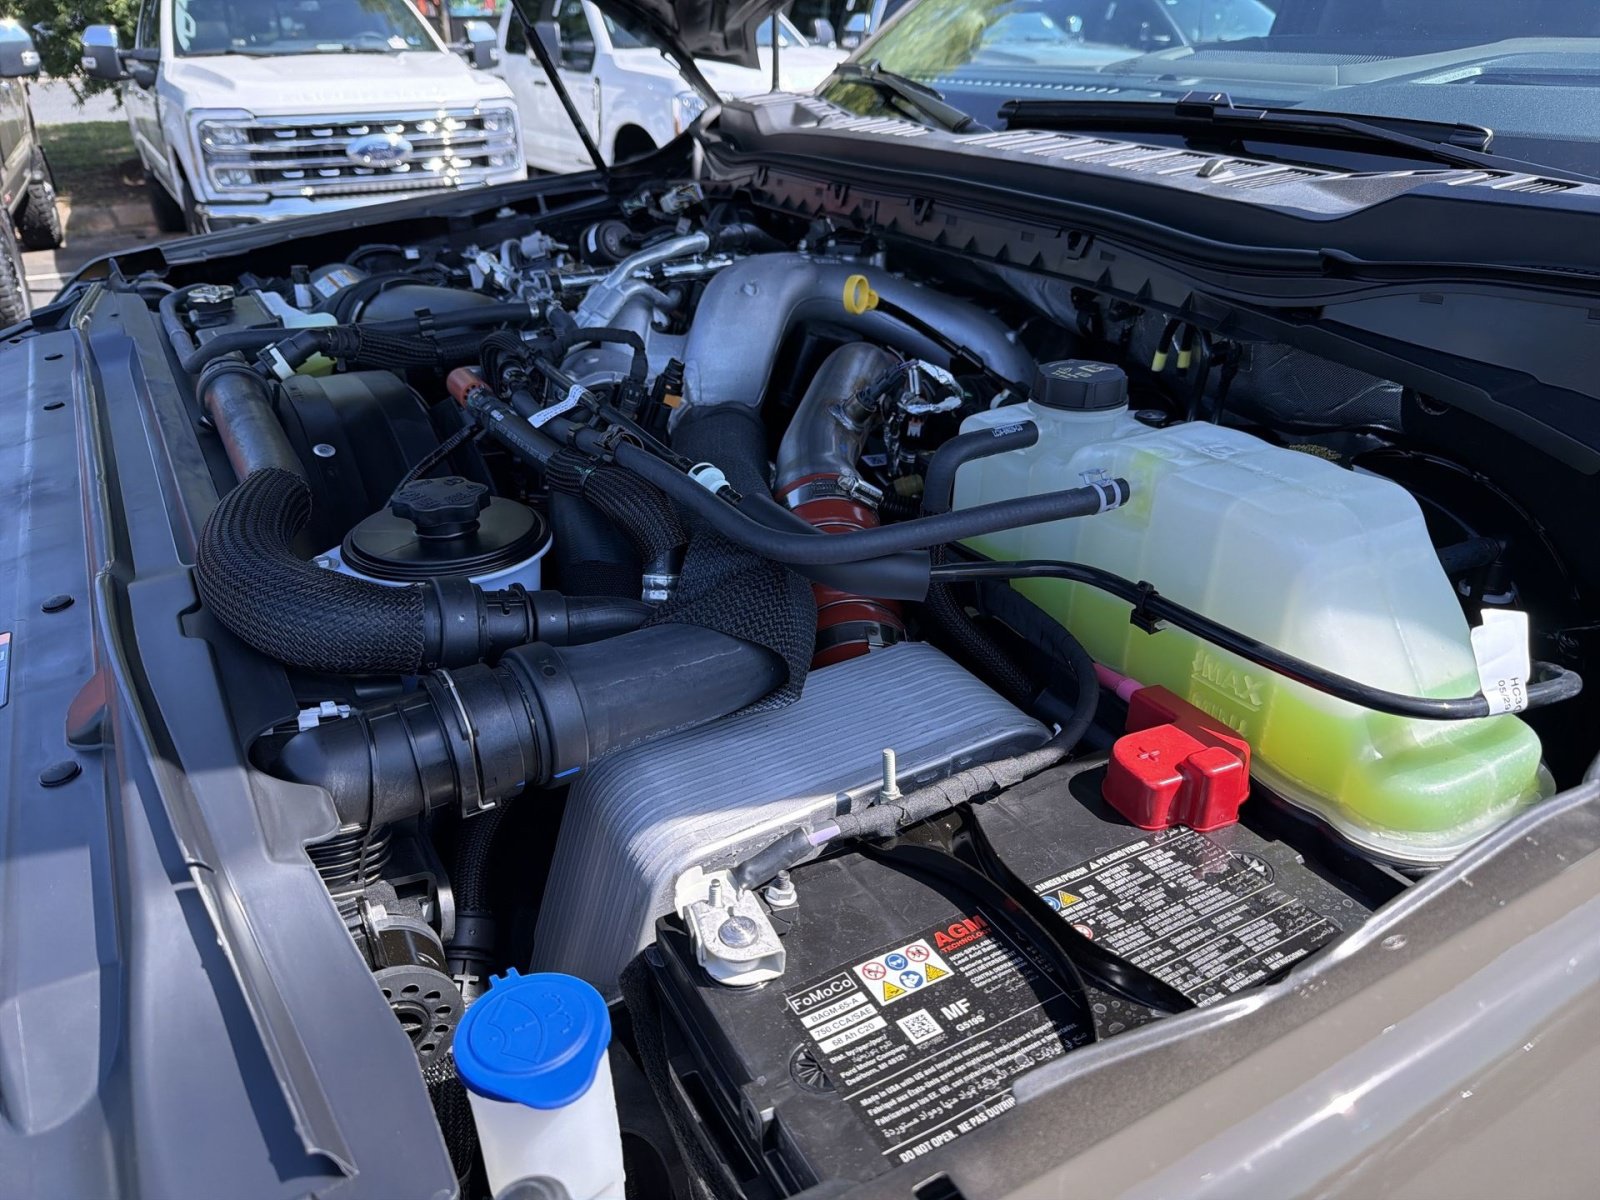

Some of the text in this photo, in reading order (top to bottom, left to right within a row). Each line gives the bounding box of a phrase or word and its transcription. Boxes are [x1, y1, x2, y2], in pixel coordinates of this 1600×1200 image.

[1202, 653, 1263, 706] MAX
[934, 914, 988, 947] AGM
[954, 956, 970, 966] Lead
[968, 950, 982, 958] Acid
[958, 960, 982, 972] Batterie
[970, 970, 994, 984] CONTRA
[791, 979, 852, 1010] FoMoCo
[810, 997, 859, 1023] BAGM-65-A
[940, 997, 971, 1021] MF
[815, 1006, 873, 1038] 750 CCA/SAE
[832, 1023, 875, 1047] 68 Ah C20
[840, 1067, 858, 1079] Ford
[857, 1059, 876, 1071] Motor
[940, 1070, 956, 1080] avec
[954, 1064, 966, 1074] des
[860, 1094, 880, 1106] Made
[878, 1090, 888, 1098] in
[884, 1084, 902, 1094] USA
[900, 1078, 916, 1088] with
[912, 1072, 924, 1080] US
[924, 1066, 936, 1076] and
[916, 1096, 930, 1106] los
[900, 1150, 916, 1162] DO
[912, 1140, 932, 1156] NOT
[930, 1130, 958, 1148] OPEN.
[956, 1120, 972, 1132] NE
[968, 1112, 988, 1126] PAS
